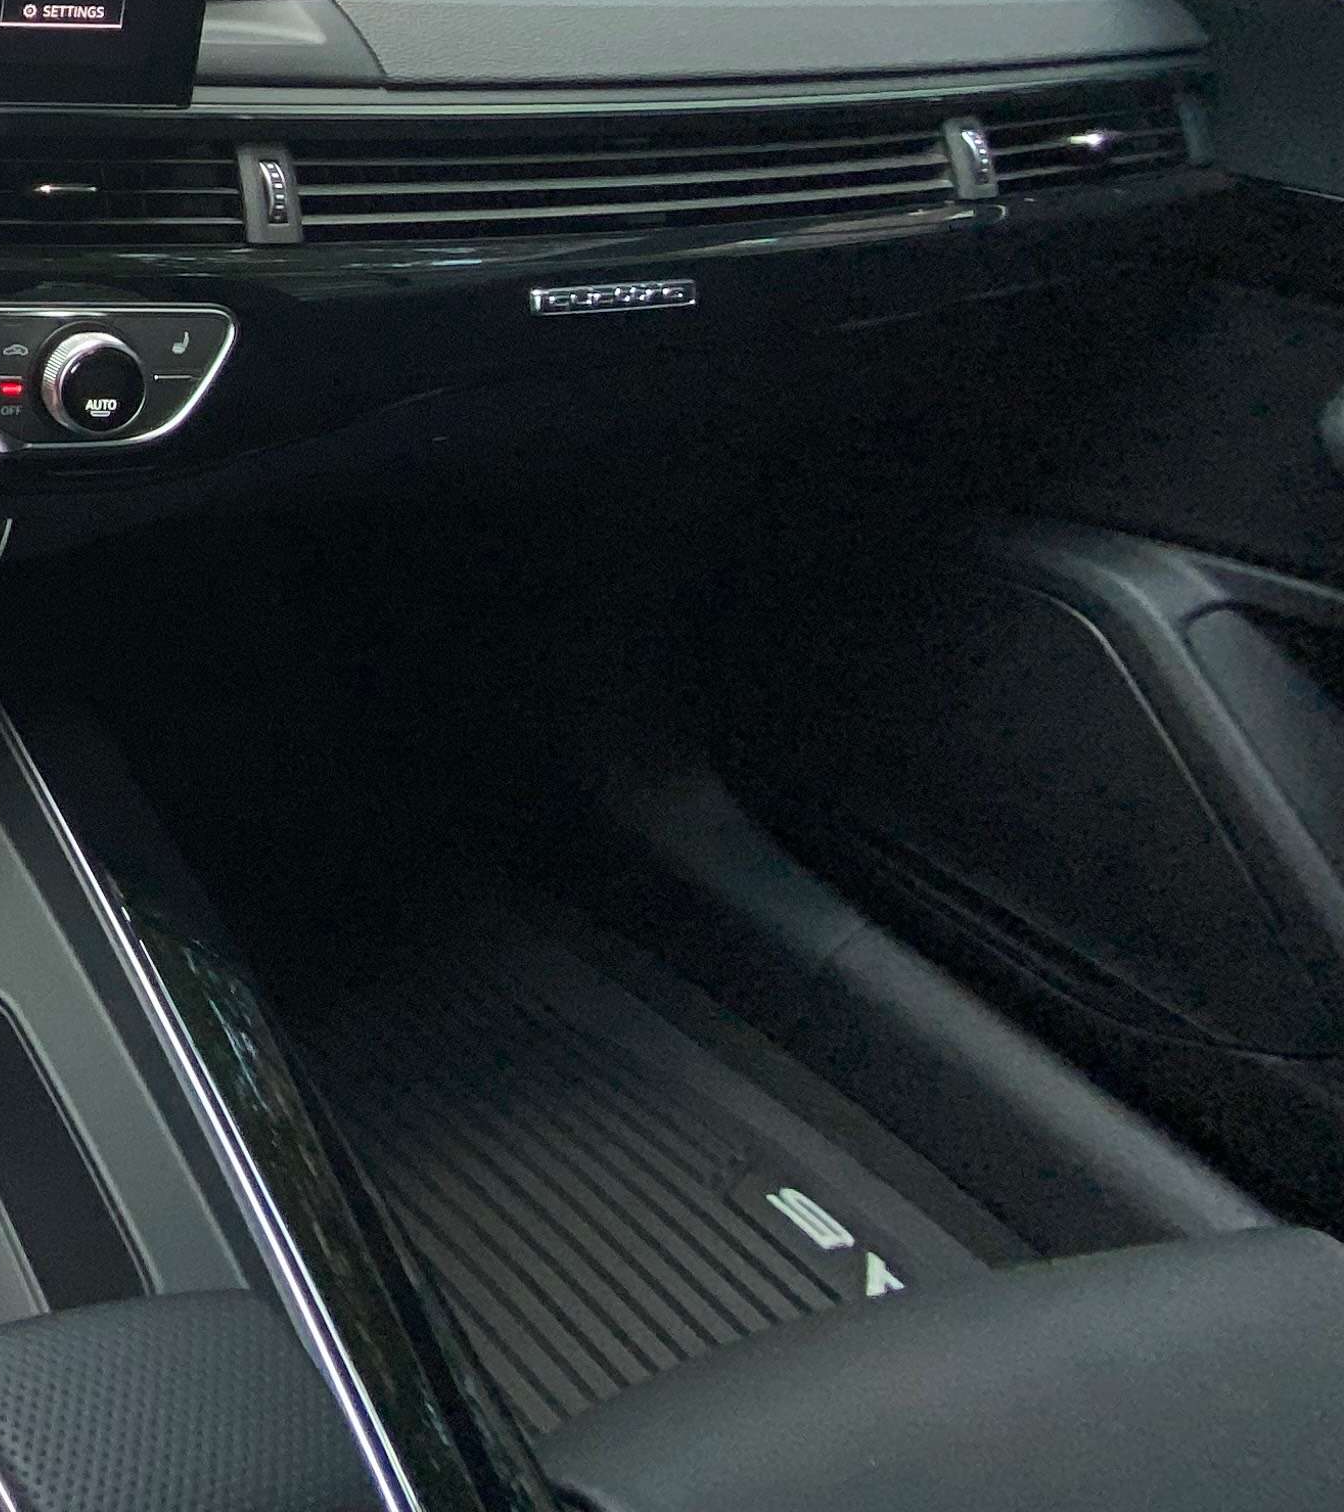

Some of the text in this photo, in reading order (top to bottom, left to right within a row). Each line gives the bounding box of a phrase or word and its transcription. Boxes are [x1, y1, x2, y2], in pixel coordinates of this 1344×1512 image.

[42, 5, 105, 18] SETTINGS
[0, 406, 21, 416] OFF
[85, 399, 117, 411] AUTO
